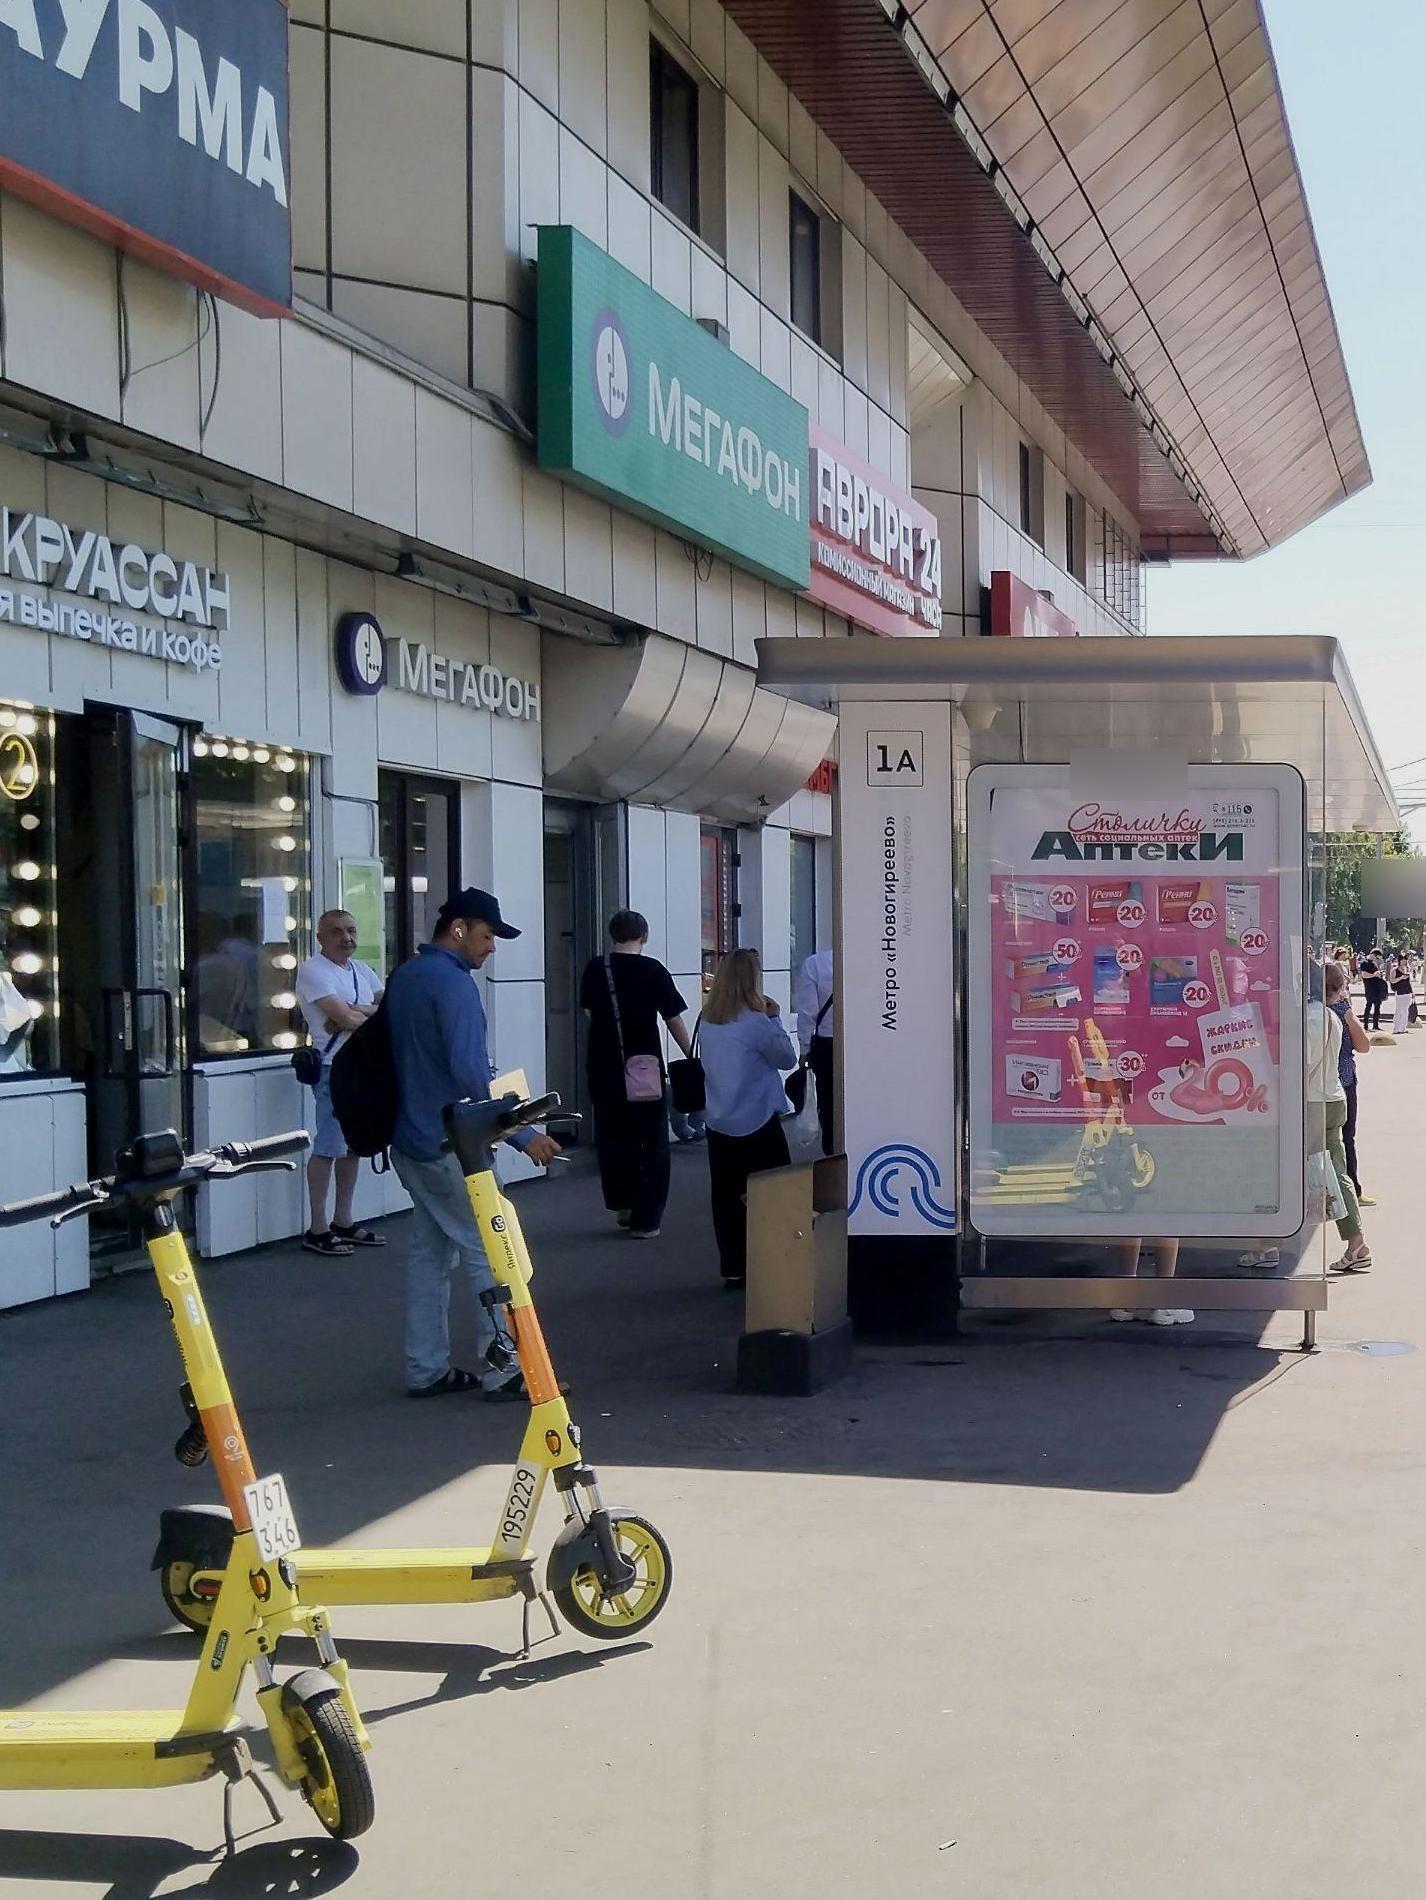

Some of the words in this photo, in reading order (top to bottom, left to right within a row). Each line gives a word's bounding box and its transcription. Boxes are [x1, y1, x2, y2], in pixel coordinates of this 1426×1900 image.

[649, 362, 800, 522] МЕГАФОН
[818, 449, 914, 580] АВРОРА
[921, 528, 941, 599] 24
[3, 506, 230, 630] КРУАССАН
[21, 593, 137, 651] выпечка
[142, 626, 157, 654] и
[162, 631, 222, 674] кофе
[400, 637, 541, 722] МЕГАФОН
[1067, 802, 1206, 833] Столички
[1099, 834, 1165, 843] социальных
[1167, 834, 1198, 842] аптек
[881, 815, 900, 963] «Новогиреево»
[881, 967, 900, 1031] Метро
[249, 1481, 283, 1518] 767
[260, 1518, 296, 1553] 346
[501, 1469, 536, 1542] 195229
